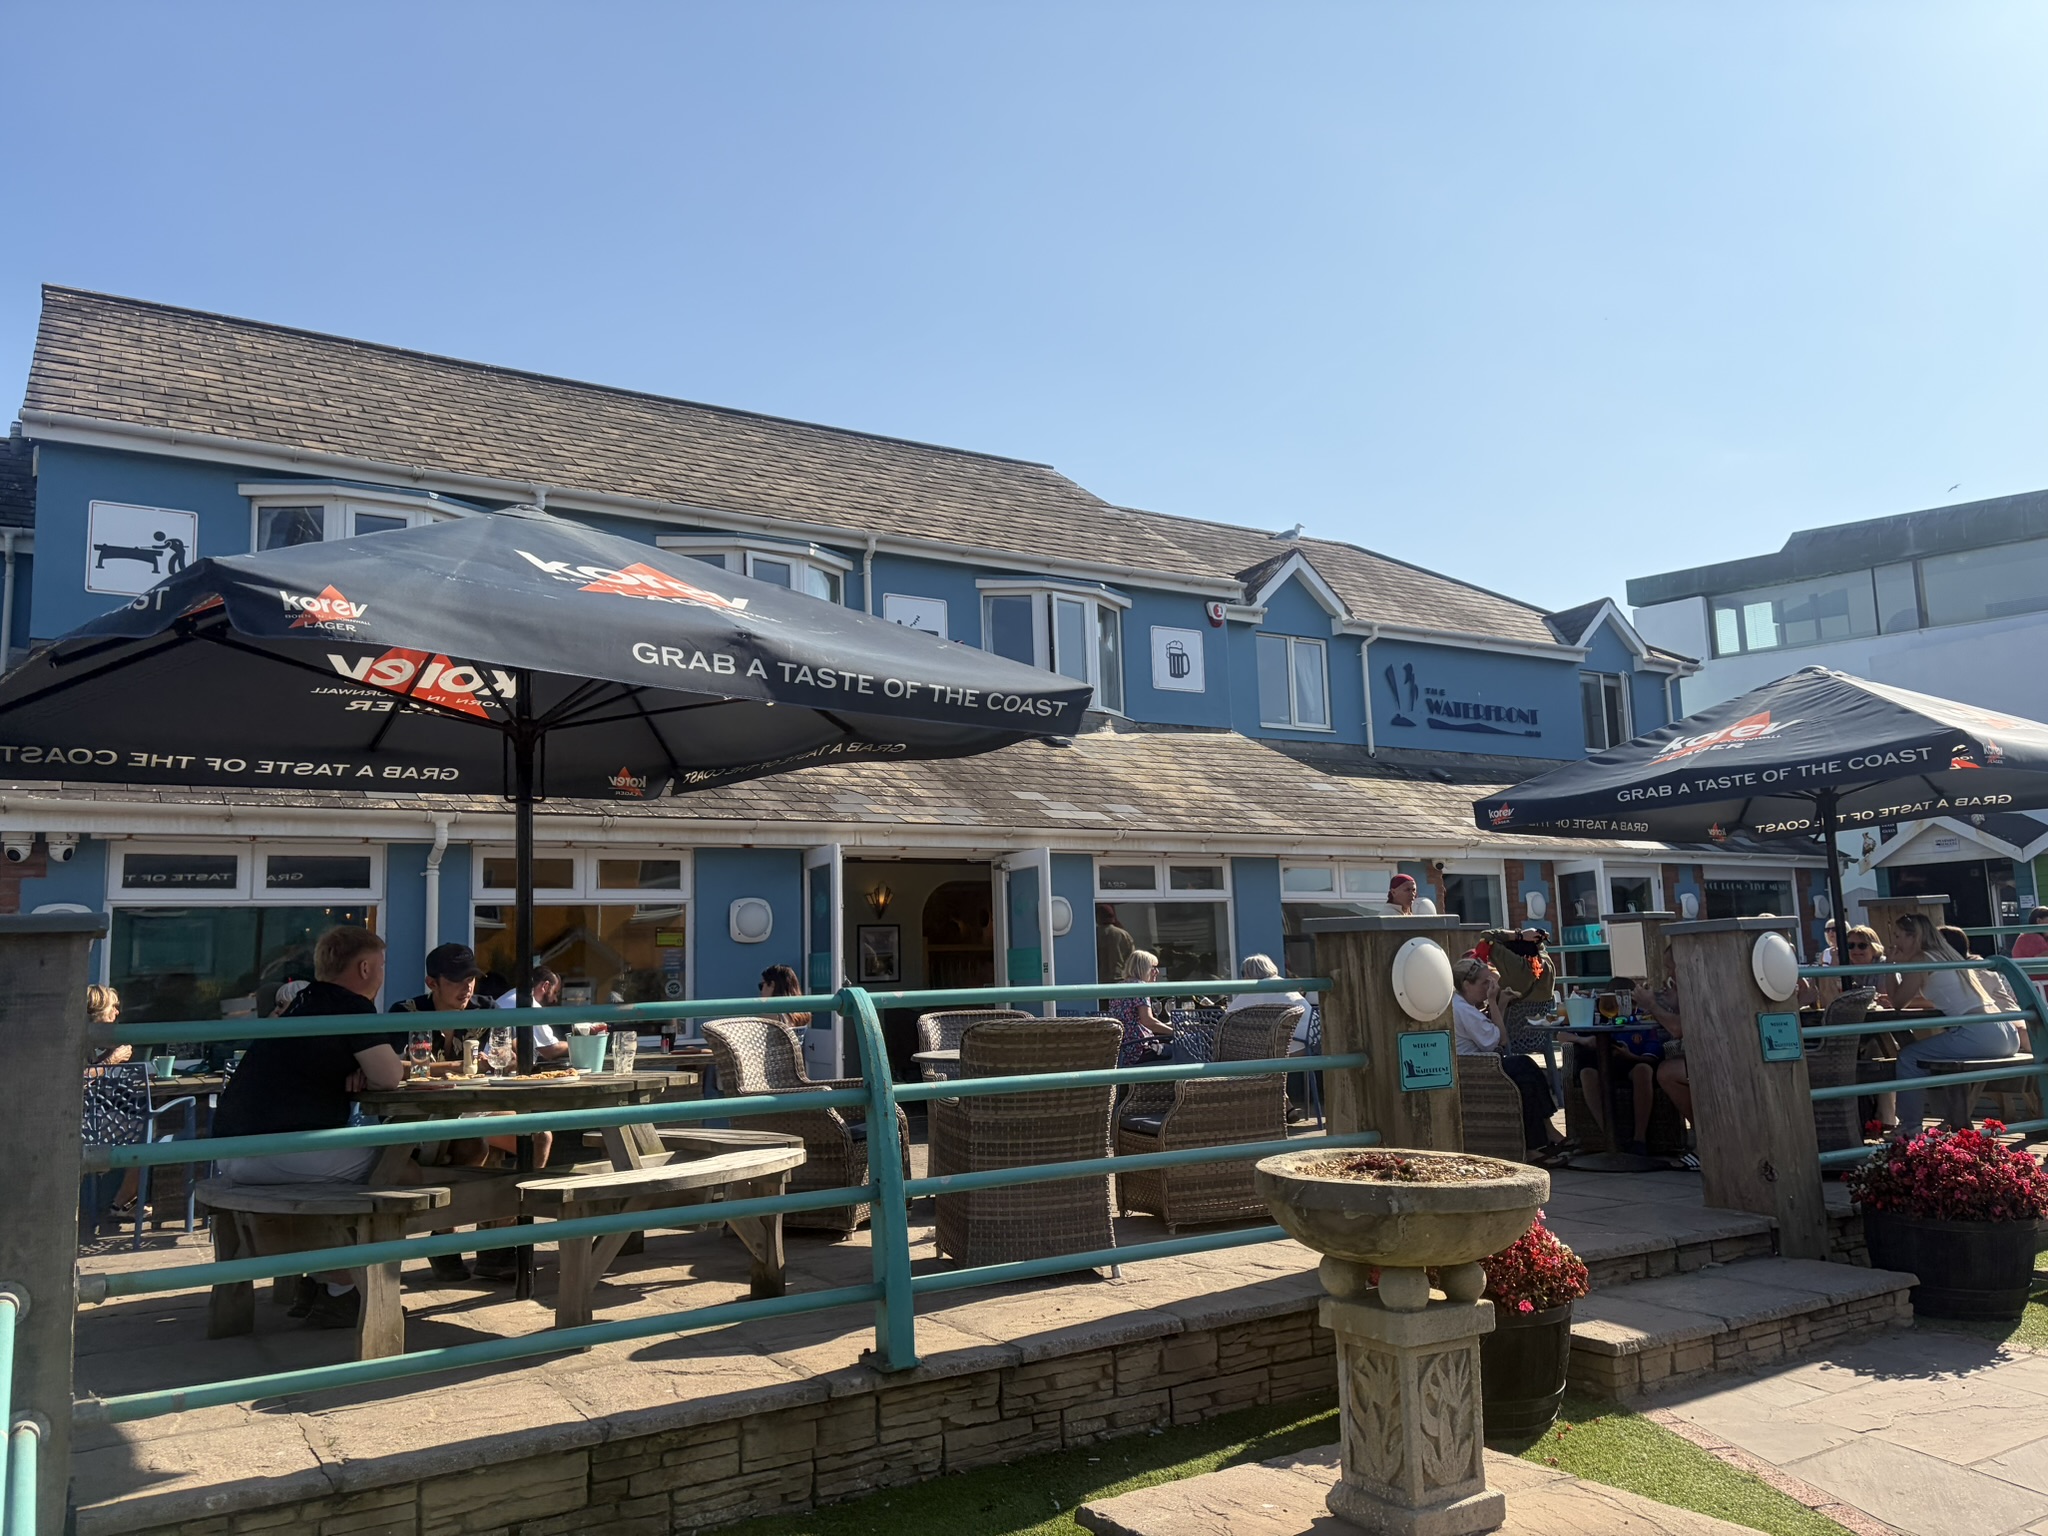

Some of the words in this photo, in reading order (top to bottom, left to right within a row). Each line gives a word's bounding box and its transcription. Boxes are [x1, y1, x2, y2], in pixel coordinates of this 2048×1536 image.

[280, 590, 368, 617] korev
[304, 621, 357, 632] LAGER
[632, 642, 736, 675] GRAB
[746, 658, 768, 680] A
[777, 662, 874, 695] TASTE
[883, 678, 922, 699] OF
[929, 683, 980, 708] THE
[986, 692, 1068, 717] COAST
[1424, 687, 1446, 697] THE
[1425, 697, 1539, 725] WATERFRONT
[1659, 719, 1804, 753] korev
[1667, 743, 1745, 761] LAGER
[1617, 785, 1673, 802] GRAB
[1678, 783, 1691, 795] A
[1695, 773, 1757, 792] TASTE
[1762, 768, 1791, 782] OF
[1797, 760, 1842, 777] THE
[1848, 747, 1932, 770] COAST
[1488, 808, 1515, 819] korev
